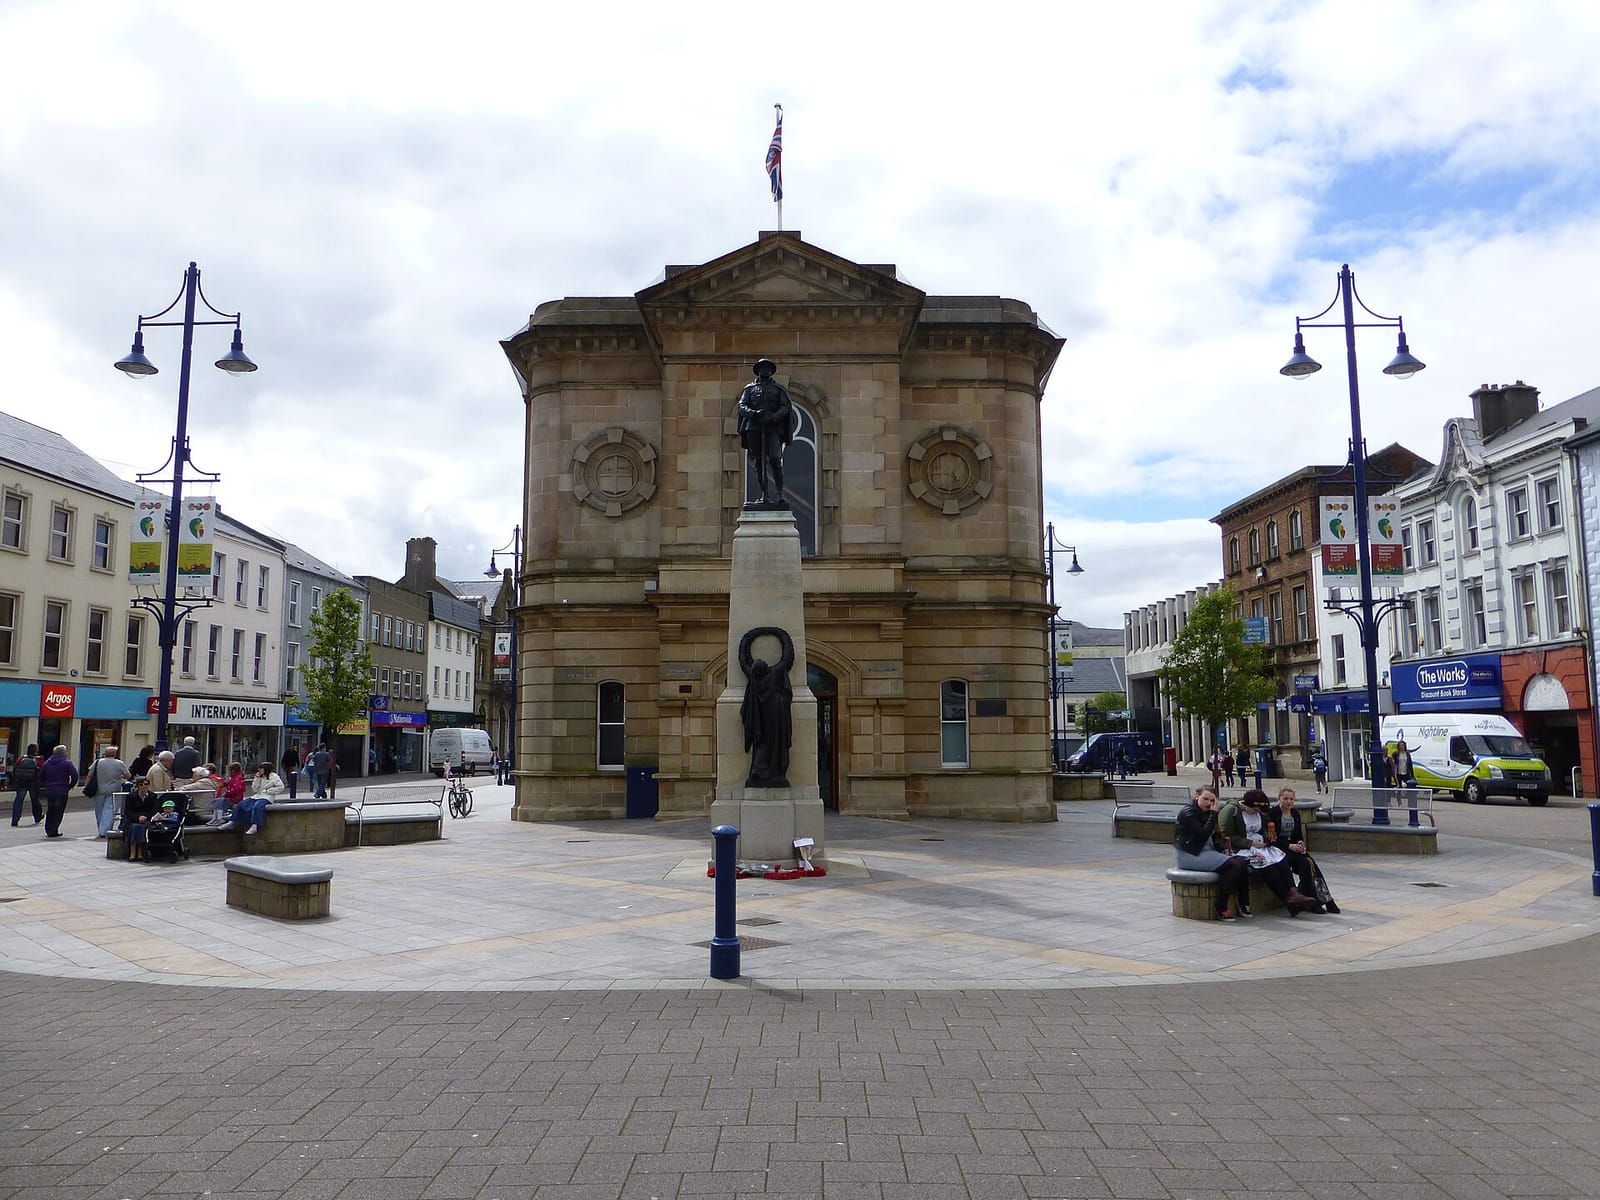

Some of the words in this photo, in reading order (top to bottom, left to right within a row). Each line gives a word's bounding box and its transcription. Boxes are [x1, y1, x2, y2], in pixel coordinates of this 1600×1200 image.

[1420, 669, 1437, 684] The
[1436, 666, 1466, 683] Works
[45, 690, 72, 706] Argos
[1421, 690, 1440, 698] Discount
[1440, 689, 1452, 697] Book
[1452, 688, 1467, 697] Stores
[1418, 725, 1449, 739] Nightline
